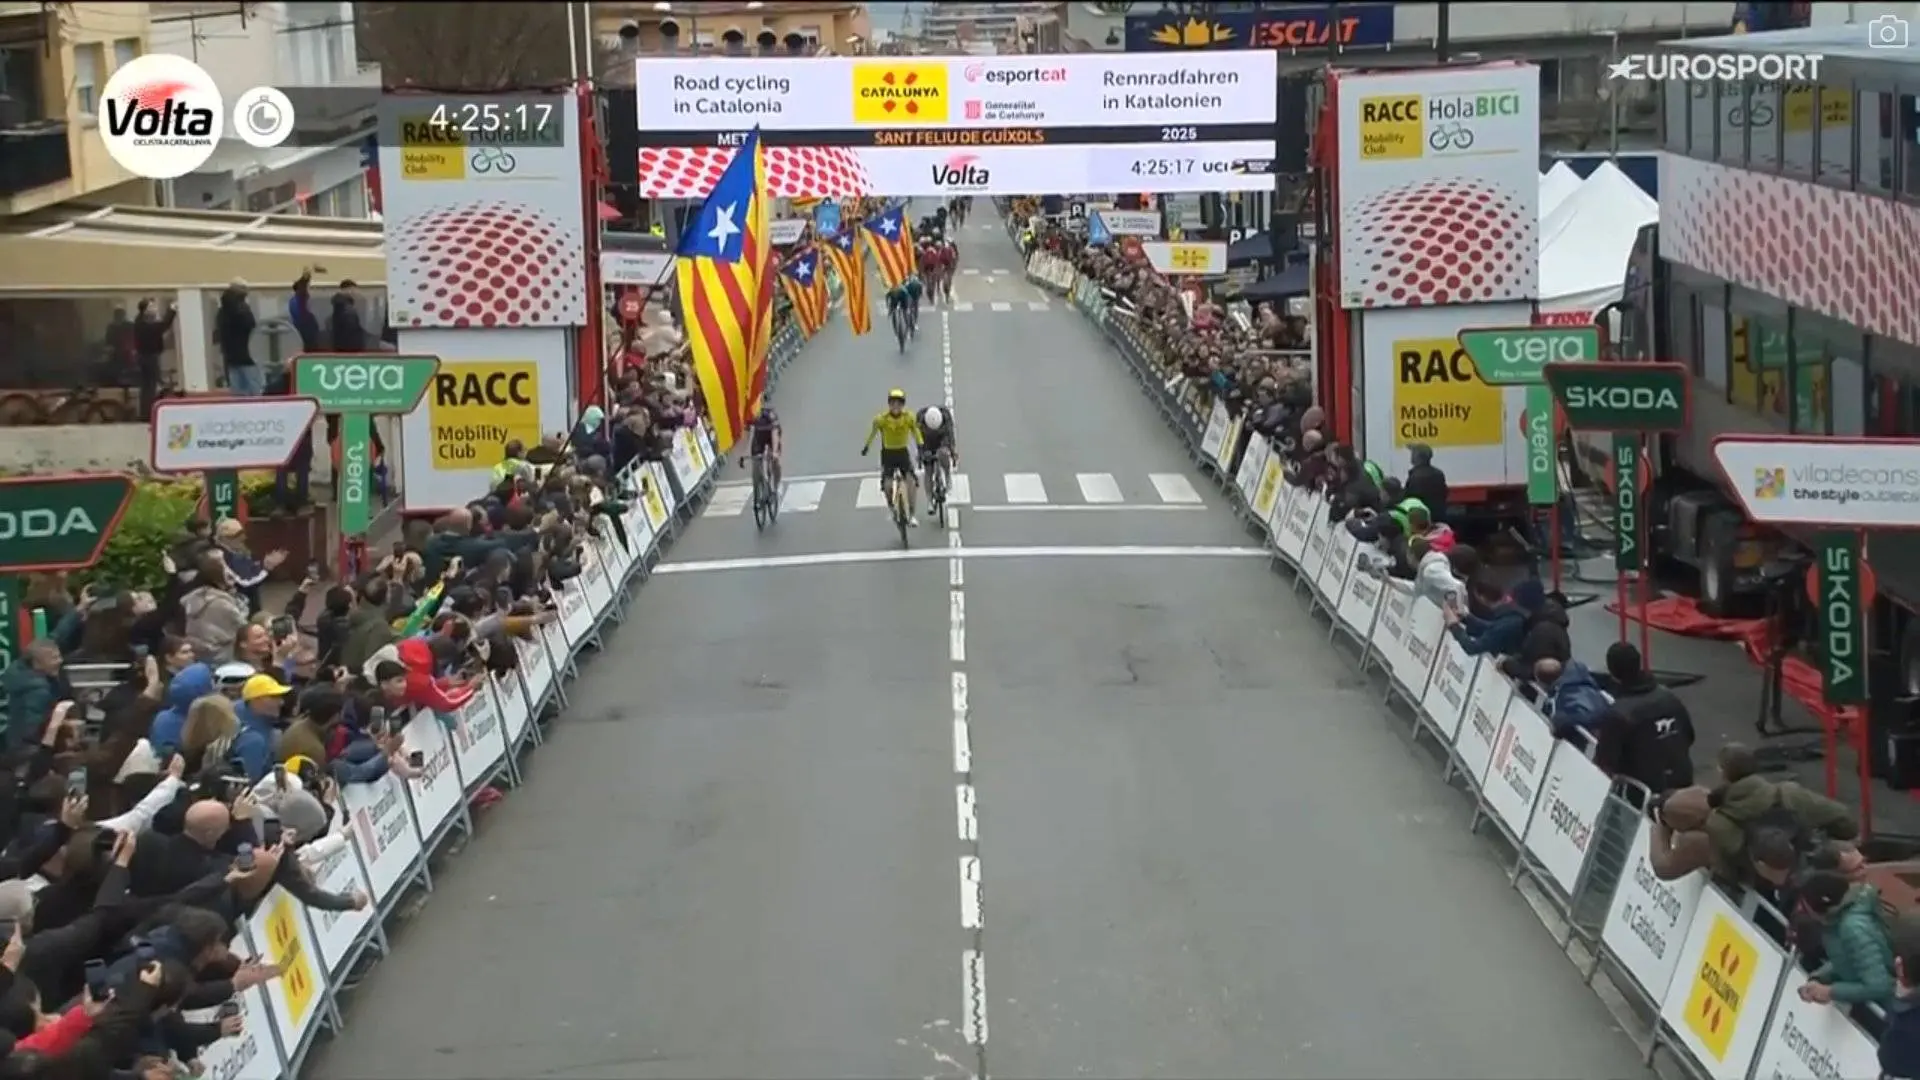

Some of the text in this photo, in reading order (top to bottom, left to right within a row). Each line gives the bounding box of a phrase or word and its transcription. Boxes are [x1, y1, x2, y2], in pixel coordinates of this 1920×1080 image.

[673, 75, 790, 94] Road cycling
[985, 67, 1067, 86] esportcat
[1103, 69, 1239, 87] Rennradfahren
[860, 86, 940, 98] CATALUNYA
[1103, 93, 1223, 110] in Katalonien
[674, 98, 783, 114] in Catalonia
[1363, 99, 1419, 123] RACC
[1429, 94, 1520, 120] HolaBICI
[717, 132, 749, 146] MET
[874, 130, 913, 145] SANT
[916, 130, 958, 144] FELIU
[960, 130, 981, 143] DE
[1161, 127, 1198, 141] 2025
[932, 163, 990, 186] Volta
[1131, 158, 1195, 176] 4:25:17
[1493, 335, 1584, 363] vera
[1400, 348, 1472, 383] RAC
[312, 363, 404, 391] vera
[435, 371, 531, 407] RACC
[1400, 403, 1472, 422] Mobility
[437, 426, 508, 443] Mobility
[1400, 424, 1439, 439] Club
[1531, 411, 1549, 473] vera
[438, 444, 476, 460] Club
[346, 440, 364, 503] vera
[1792, 461, 1920, 486] viladecans
